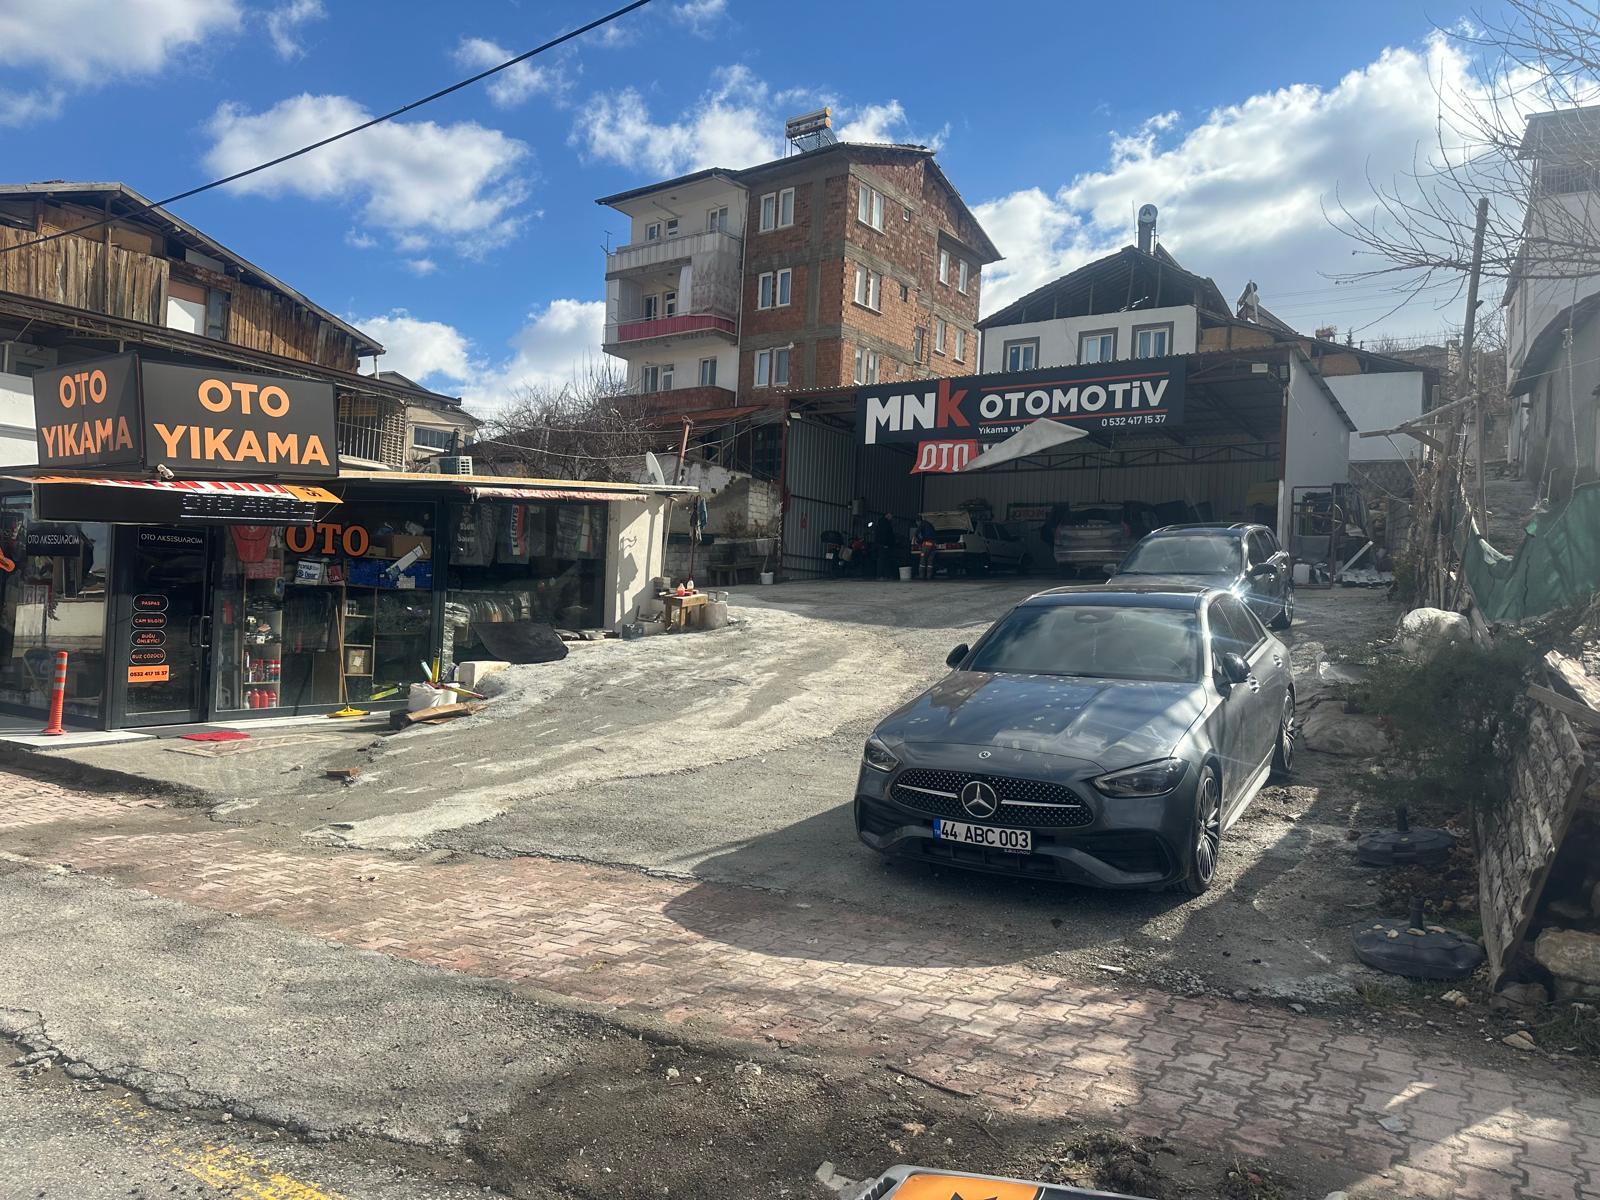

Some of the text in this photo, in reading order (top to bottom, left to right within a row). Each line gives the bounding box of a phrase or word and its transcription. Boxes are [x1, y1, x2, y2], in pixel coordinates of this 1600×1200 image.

[59, 369, 107, 409] OTO
[198, 378, 290, 417] OTO
[865, 379, 971, 444] MNK
[1101, 414, 1166, 426] 0 532 417 15 37
[41, 416, 133, 458] YIKAMA
[154, 423, 329, 466] YIKAMA
[918, 443, 969, 472] OTO
[27, 534, 39, 544] OTO
[140, 532, 156, 541] OTO
[285, 522, 369, 557] OTO
[941, 821, 958, 840] 44
[963, 825, 996, 845] ABC
[999, 829, 1029, 849] 003
